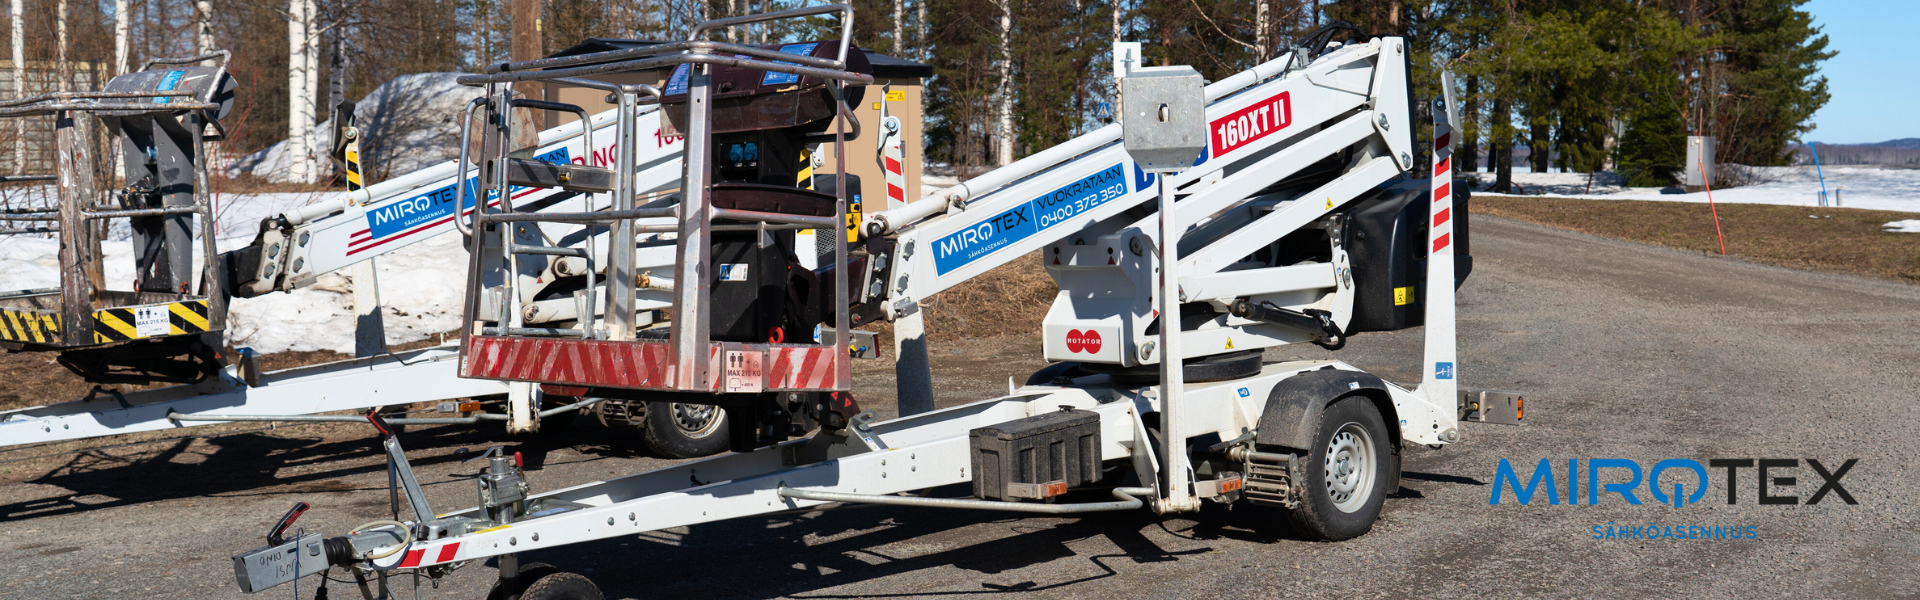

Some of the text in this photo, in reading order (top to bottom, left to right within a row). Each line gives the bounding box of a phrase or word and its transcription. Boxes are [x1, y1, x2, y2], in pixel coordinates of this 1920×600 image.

[1217, 104, 1270, 150] 160XT
[1037, 165, 1121, 210] VUOKRATAAN
[1040, 183, 1124, 227] 0400 372 350
[940, 206, 1028, 259] MIROTEX
[1067, 337, 1101, 345] ROTATOR
